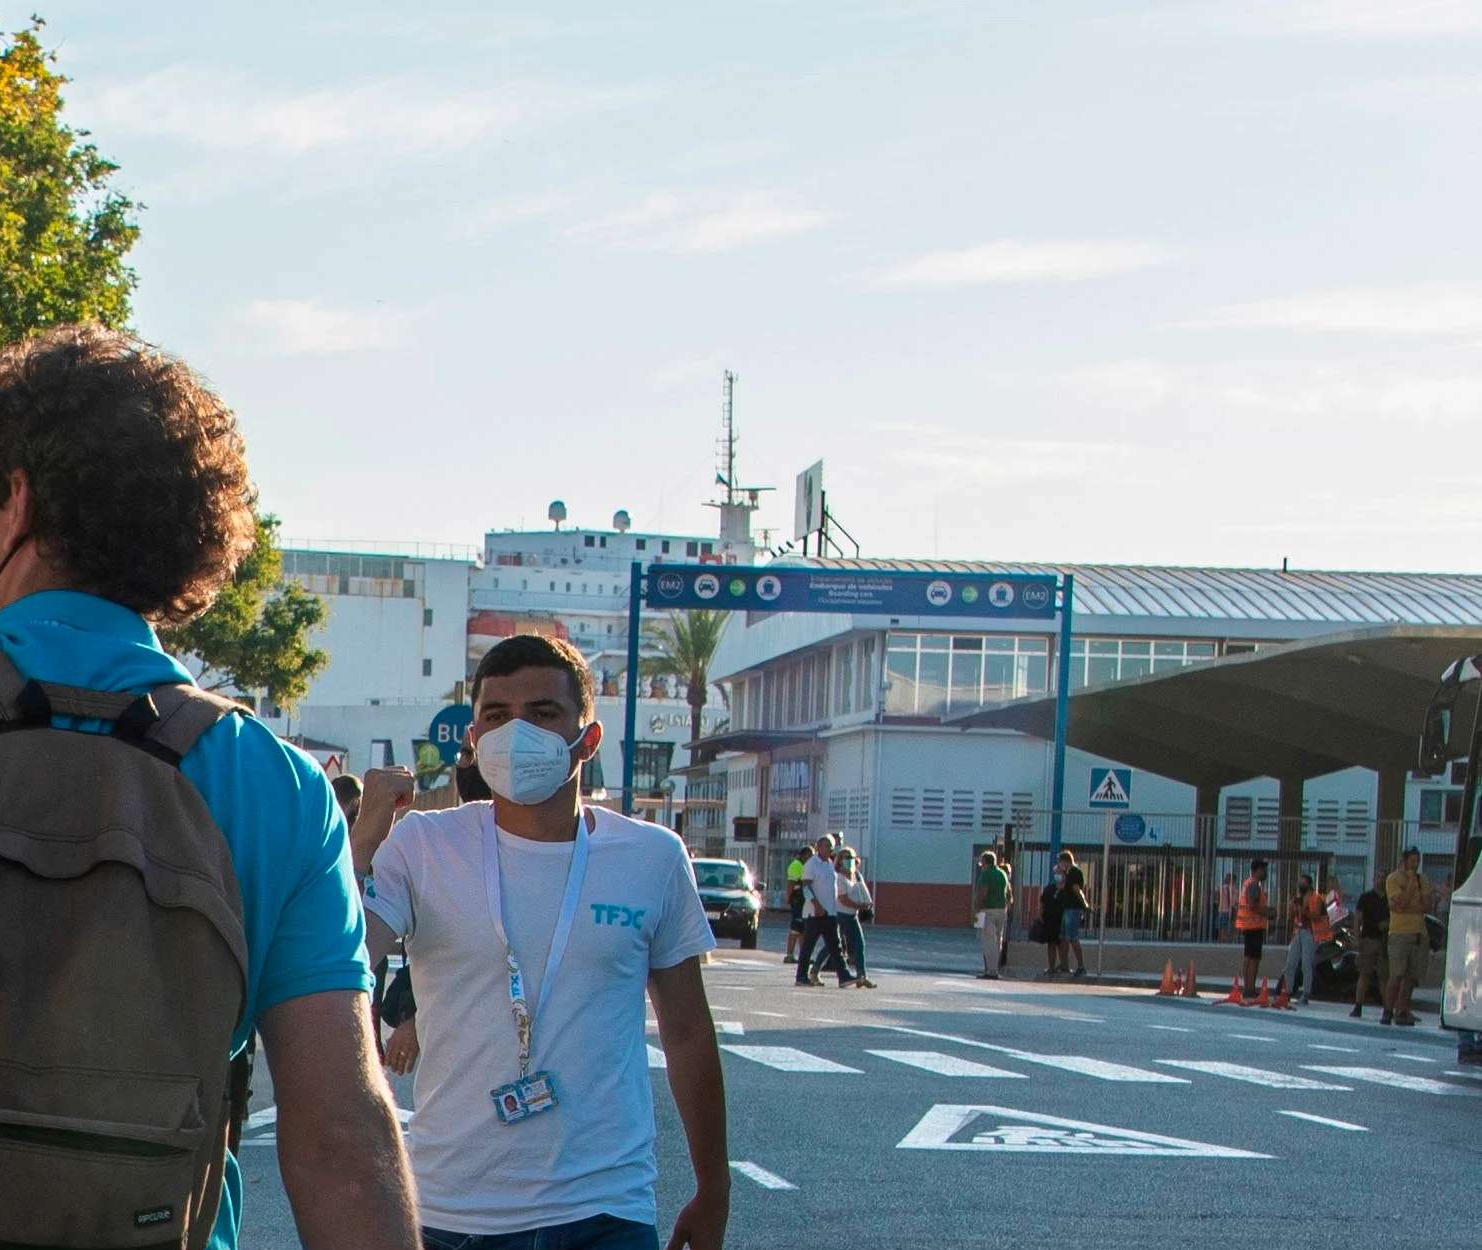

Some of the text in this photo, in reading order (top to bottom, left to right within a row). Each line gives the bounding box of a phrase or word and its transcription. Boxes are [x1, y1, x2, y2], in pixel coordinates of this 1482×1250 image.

[659, 580, 681, 590] EM2
[1025, 590, 1046, 600] EM2
[438, 723, 469, 744] BU
